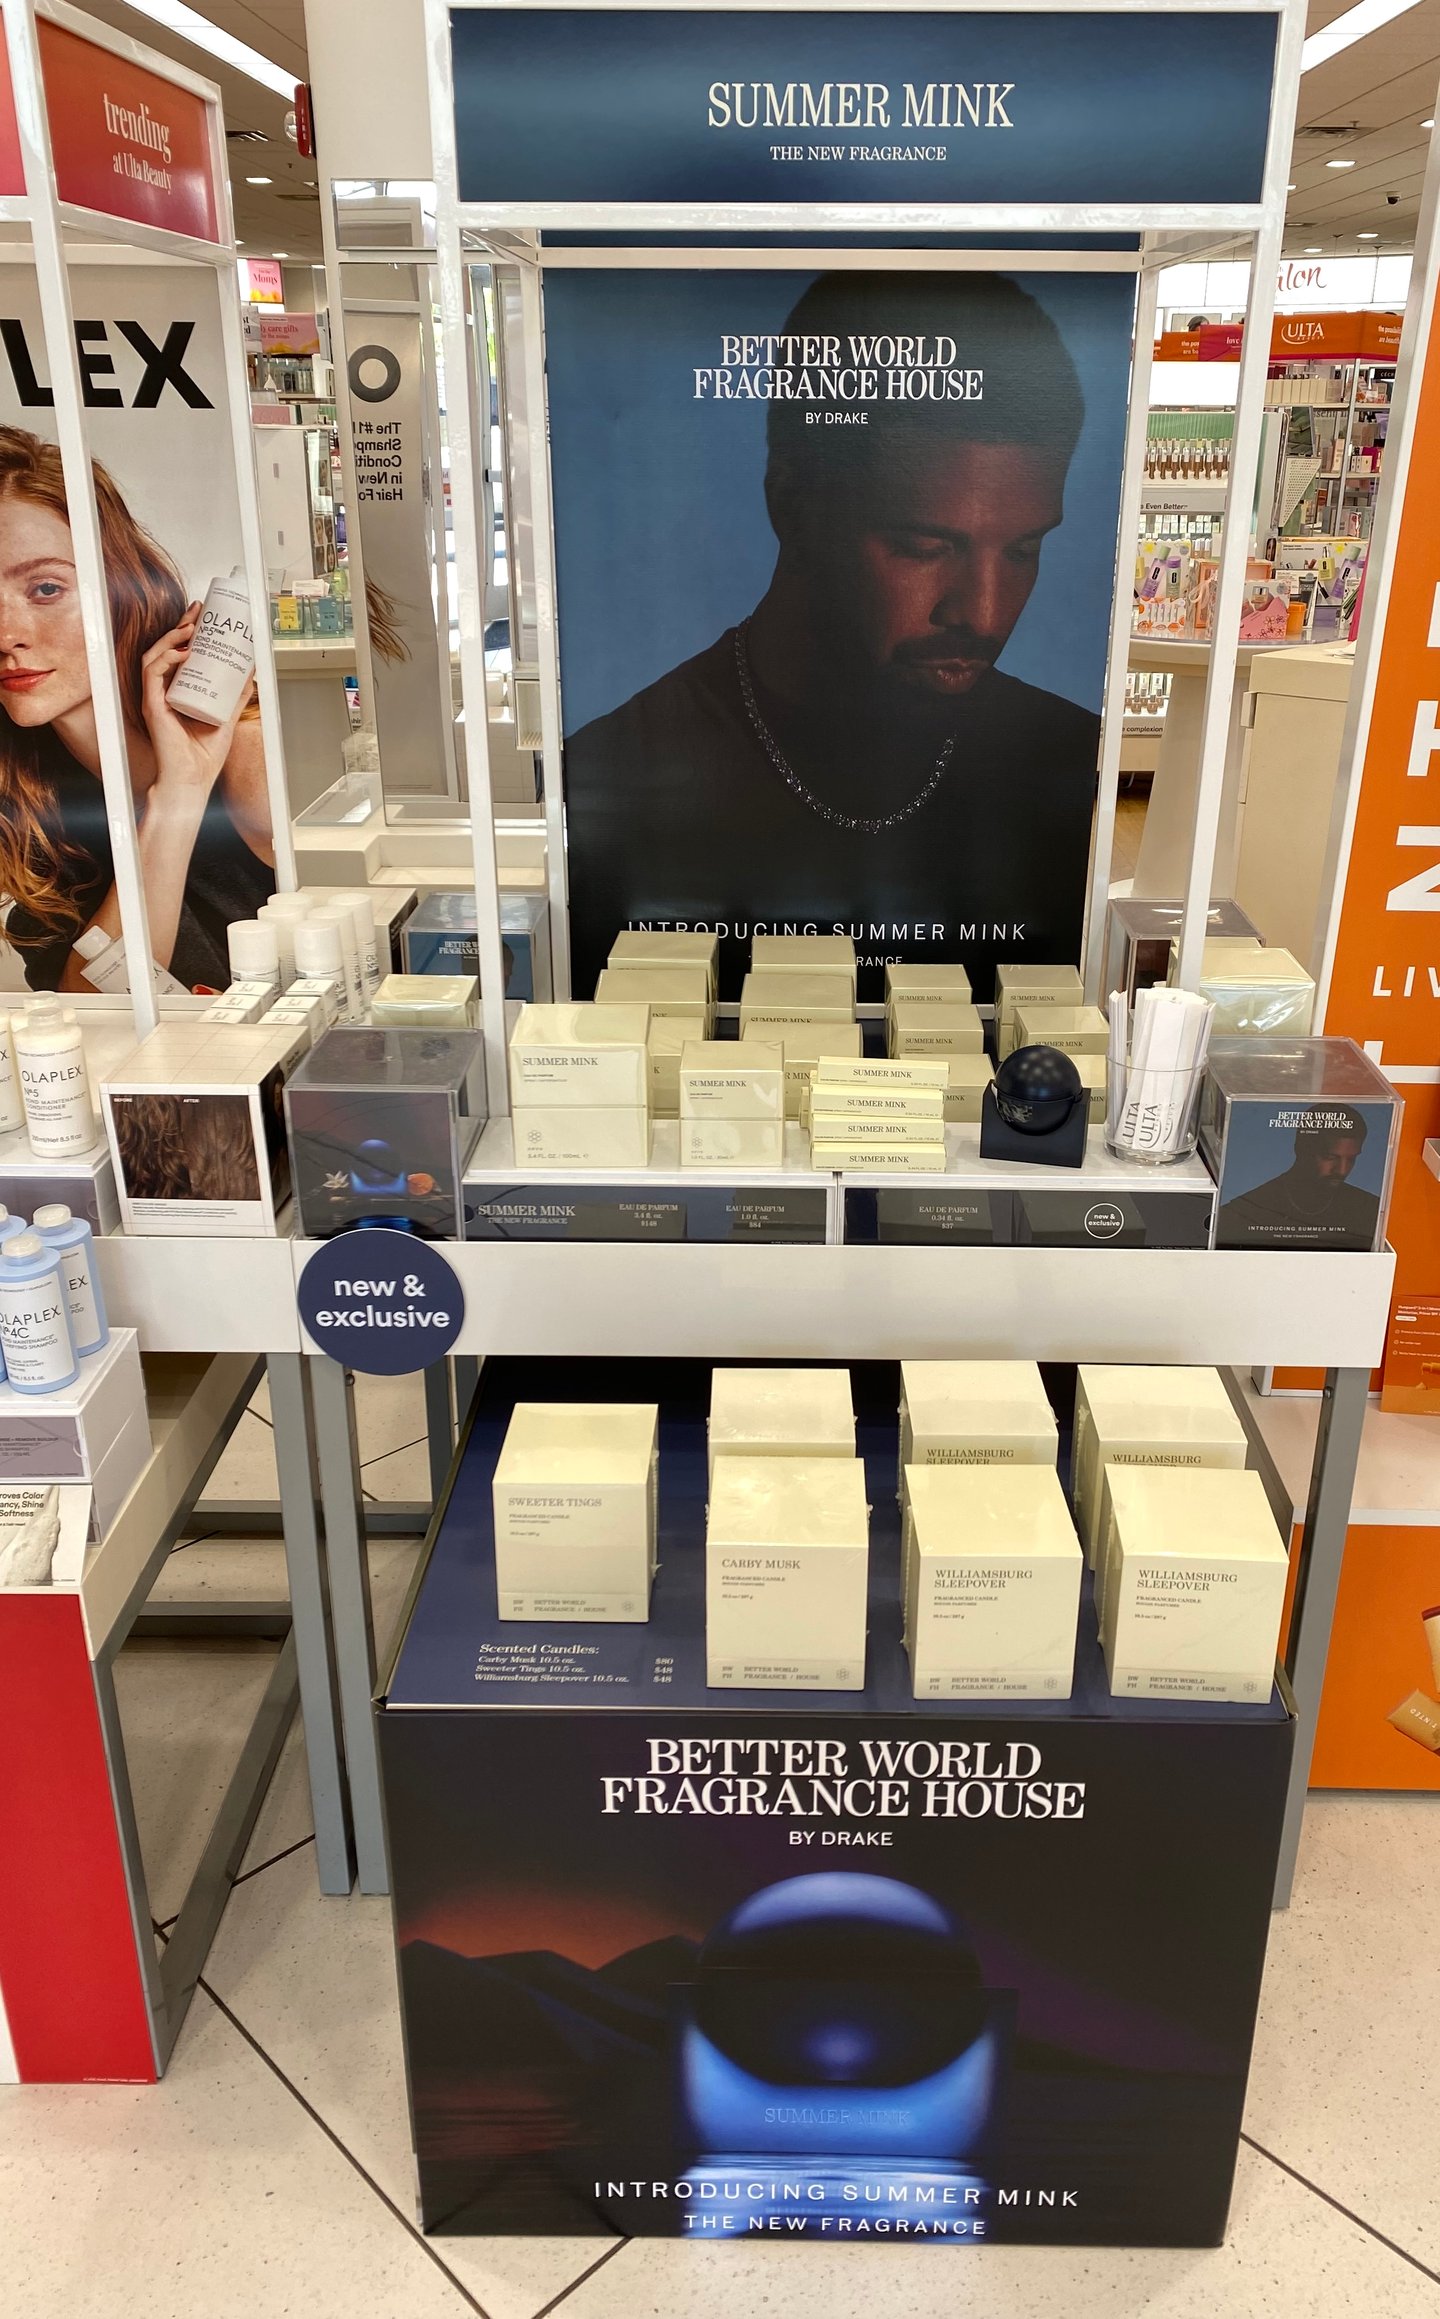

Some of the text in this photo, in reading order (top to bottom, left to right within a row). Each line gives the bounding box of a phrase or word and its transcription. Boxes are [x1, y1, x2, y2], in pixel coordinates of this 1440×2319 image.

[708, 81, 1016, 128] SUMMER MINK
[103, 93, 171, 164] trending
[770, 145, 947, 161] THE NEW FRAGRANCE
[113, 152, 172, 195] at Ulta Beauty
[252, 272, 278, 286] Moms
[1287, 322, 1325, 337] ULTA
[720, 335, 957, 367] BETTER WORLD
[693, 368, 984, 400] FRAGRANCE HOUSE
[805, 412, 869, 425] BY DRAKE
[192, 641, 233, 657] CONDITIONER
[628, 921, 1027, 941] INTRODUCING SUMMER MINK
[905, 1037, 935, 1045] SUMMER
[522, 1057, 599, 1066] SUMMER MINK
[853, 1068, 912, 1079] SUMMER MINK
[847, 1099, 907, 1108] SUMMER MINK
[1122, 1102, 1140, 1138] ULTA
[1278, 1111, 1347, 1121] BETTER WORLD
[848, 1125, 907, 1133] SUMMER MINK
[1139, 1105, 1158, 1142] ULTA
[1269, 1119, 1354, 1129] FRAGRANCE HOUSE
[849, 1155, 910, 1163] SUMMER MINK
[478, 1204, 576, 1217] SUMMER MINK
[725, 1205, 785, 1213] EAU DE PARFUM
[919, 1206, 978, 1214] EAU DE PARFUM
[931, 1214, 945, 1222] 0.34
[333, 1274, 426, 1297] new &
[315, 1304, 450, 1329] exclusive
[28, 1339, 59, 1349] SHAMPOO
[926, 1448, 1014, 1458] WILLIAMSBURG
[1112, 1454, 1202, 1464] WILLIAMSBURG
[22, 1491, 44, 1499] Color
[22, 1500, 45, 1508] Shine
[508, 1497, 602, 1507] SWEETER TINGS
[722, 1558, 801, 1569] CARBY MUSK
[935, 1569, 1033, 1579] WILLIAMSBURG
[1138, 1569, 1238, 1583] WILLIAMSBURG
[934, 1579, 1006, 1589] SLEEPOVER
[1136, 1579, 1210, 1591] SLEEPOVER
[480, 1644, 600, 1655] Scented Candles:
[478, 1656, 507, 1664] Carby
[510, 1656, 536, 1664] Musk
[539, 1656, 559, 1664] 10.5
[655, 1657, 674, 1665] $80
[519, 1665, 546, 1673] Tings
[548, 1665, 569, 1673] 10.5
[654, 1666, 673, 1674] $48
[475, 1674, 538, 1682] Williamsburg
[540, 1674, 590, 1683] Sleepover
[592, 1674, 613, 1683] 10.5
[653, 1675, 672, 1683] $48
[1149, 1683, 1193, 1691] FRAGRANCE
[646, 1738, 1042, 1779] BETTER WORLD
[600, 1777, 1086, 1819] FRAGRANCE HOUSE
[789, 1831, 894, 1847] BY DRAKE
[763, 2106, 911, 2126] SUMMER MINK
[594, 2181, 1079, 2208] INTRODUCING SUMMER MINK
[684, 2215, 986, 2236] THE NEW FRAGRANCE
